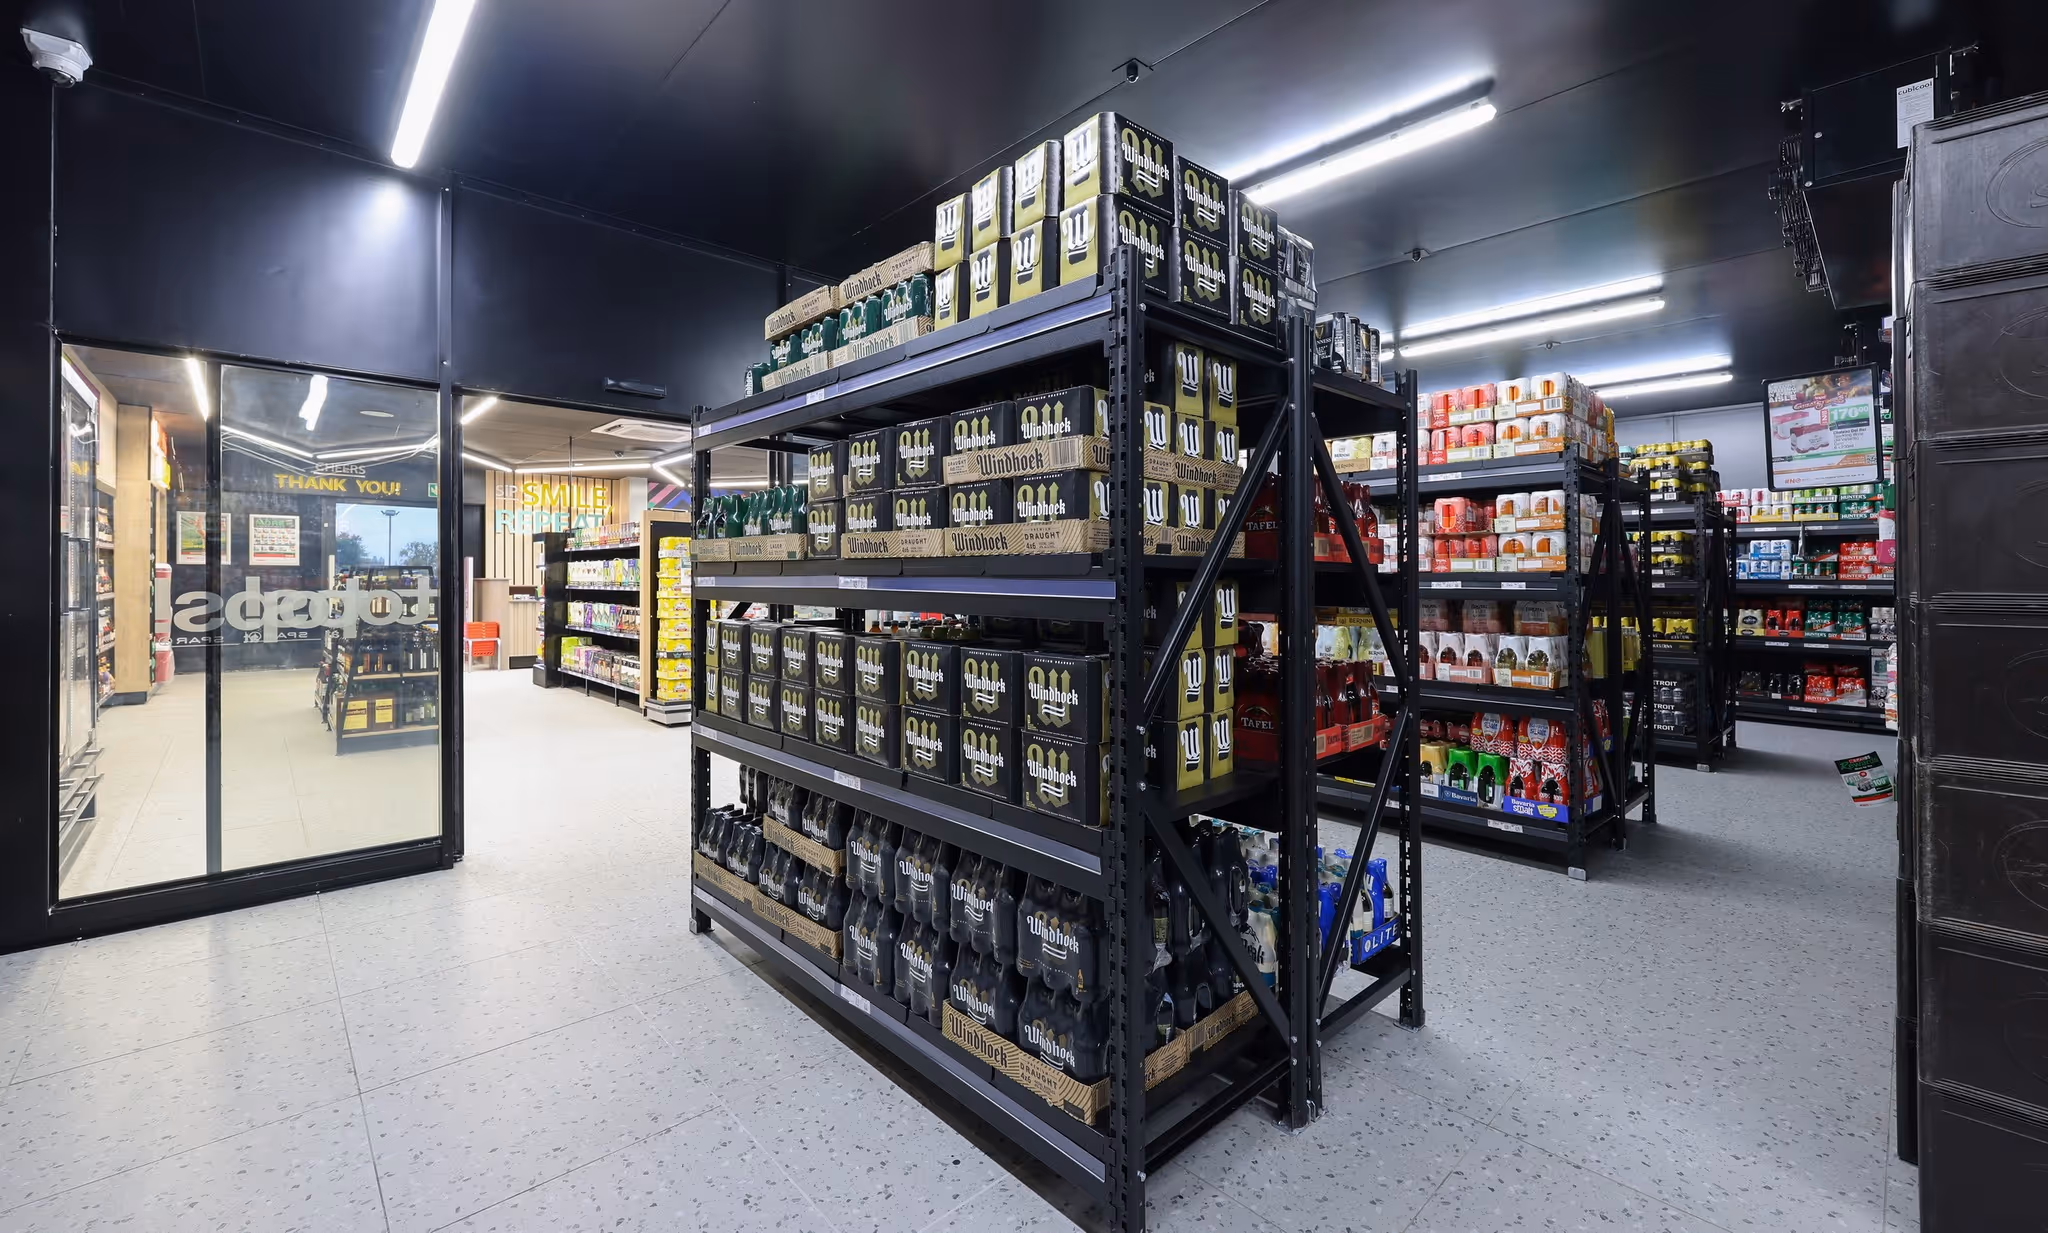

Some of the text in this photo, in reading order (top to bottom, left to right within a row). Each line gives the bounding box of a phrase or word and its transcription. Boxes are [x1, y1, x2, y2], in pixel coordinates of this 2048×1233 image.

[1897, 81, 1933, 96] cubicool
[1121, 142, 1170, 181] Windhoek
[1184, 182, 1226, 216] Windhoek
[1241, 215, 1275, 245] Windhoek
[1118, 224, 1165, 261] Windhoek
[1184, 253, 1226, 284] Windhoek
[843, 271, 882, 300] Windhoek
[1242, 281, 1276, 309] Windhoek
[768, 310, 797, 333] Windhoek
[1021, 416, 1072, 441] Windhoek
[899, 441, 935, 460] Windhoek
[954, 430, 996, 452] Windhoek
[315, 462, 366, 475] CHEERS
[851, 451, 880, 468] Windhoek
[975, 448, 1046, 477] Windhoek
[274, 472, 401, 496] THANK YOU!
[1175, 461, 1217, 484] Windhoek
[895, 511, 932, 527] Windhoek
[952, 504, 994, 524] Windhoek
[1016, 499, 1066, 518] Windhoek
[496, 509, 605, 535] REPEAT
[1246, 521, 1279, 531] TAFEL
[847, 537, 889, 554] Windhoek
[951, 530, 1061, 552] Windhoek DRAUGHT
[1176, 534, 1210, 553] Windho
[906, 663, 944, 683] Windhoek
[964, 672, 1006, 694] Windhoek
[1028, 681, 1079, 706] Windhoek
[1240, 716, 1275, 730] TAFEL
[905, 729, 943, 753] Windhoek
[963, 742, 1004, 768] Windhoek
[1026, 759, 1077, 788] Windhoek
[1450, 792, 1477, 804] Bavaria
[1511, 798, 1536, 808] Bavaria
[951, 880, 994, 914] Windhoek
[1026, 915, 1079, 955] Windhoek
[952, 984, 996, 1020] Windhoek
[949, 1012, 1058, 1091] Windhoek DRAUGHT
[1024, 1024, 1076, 1068] Windhoek
